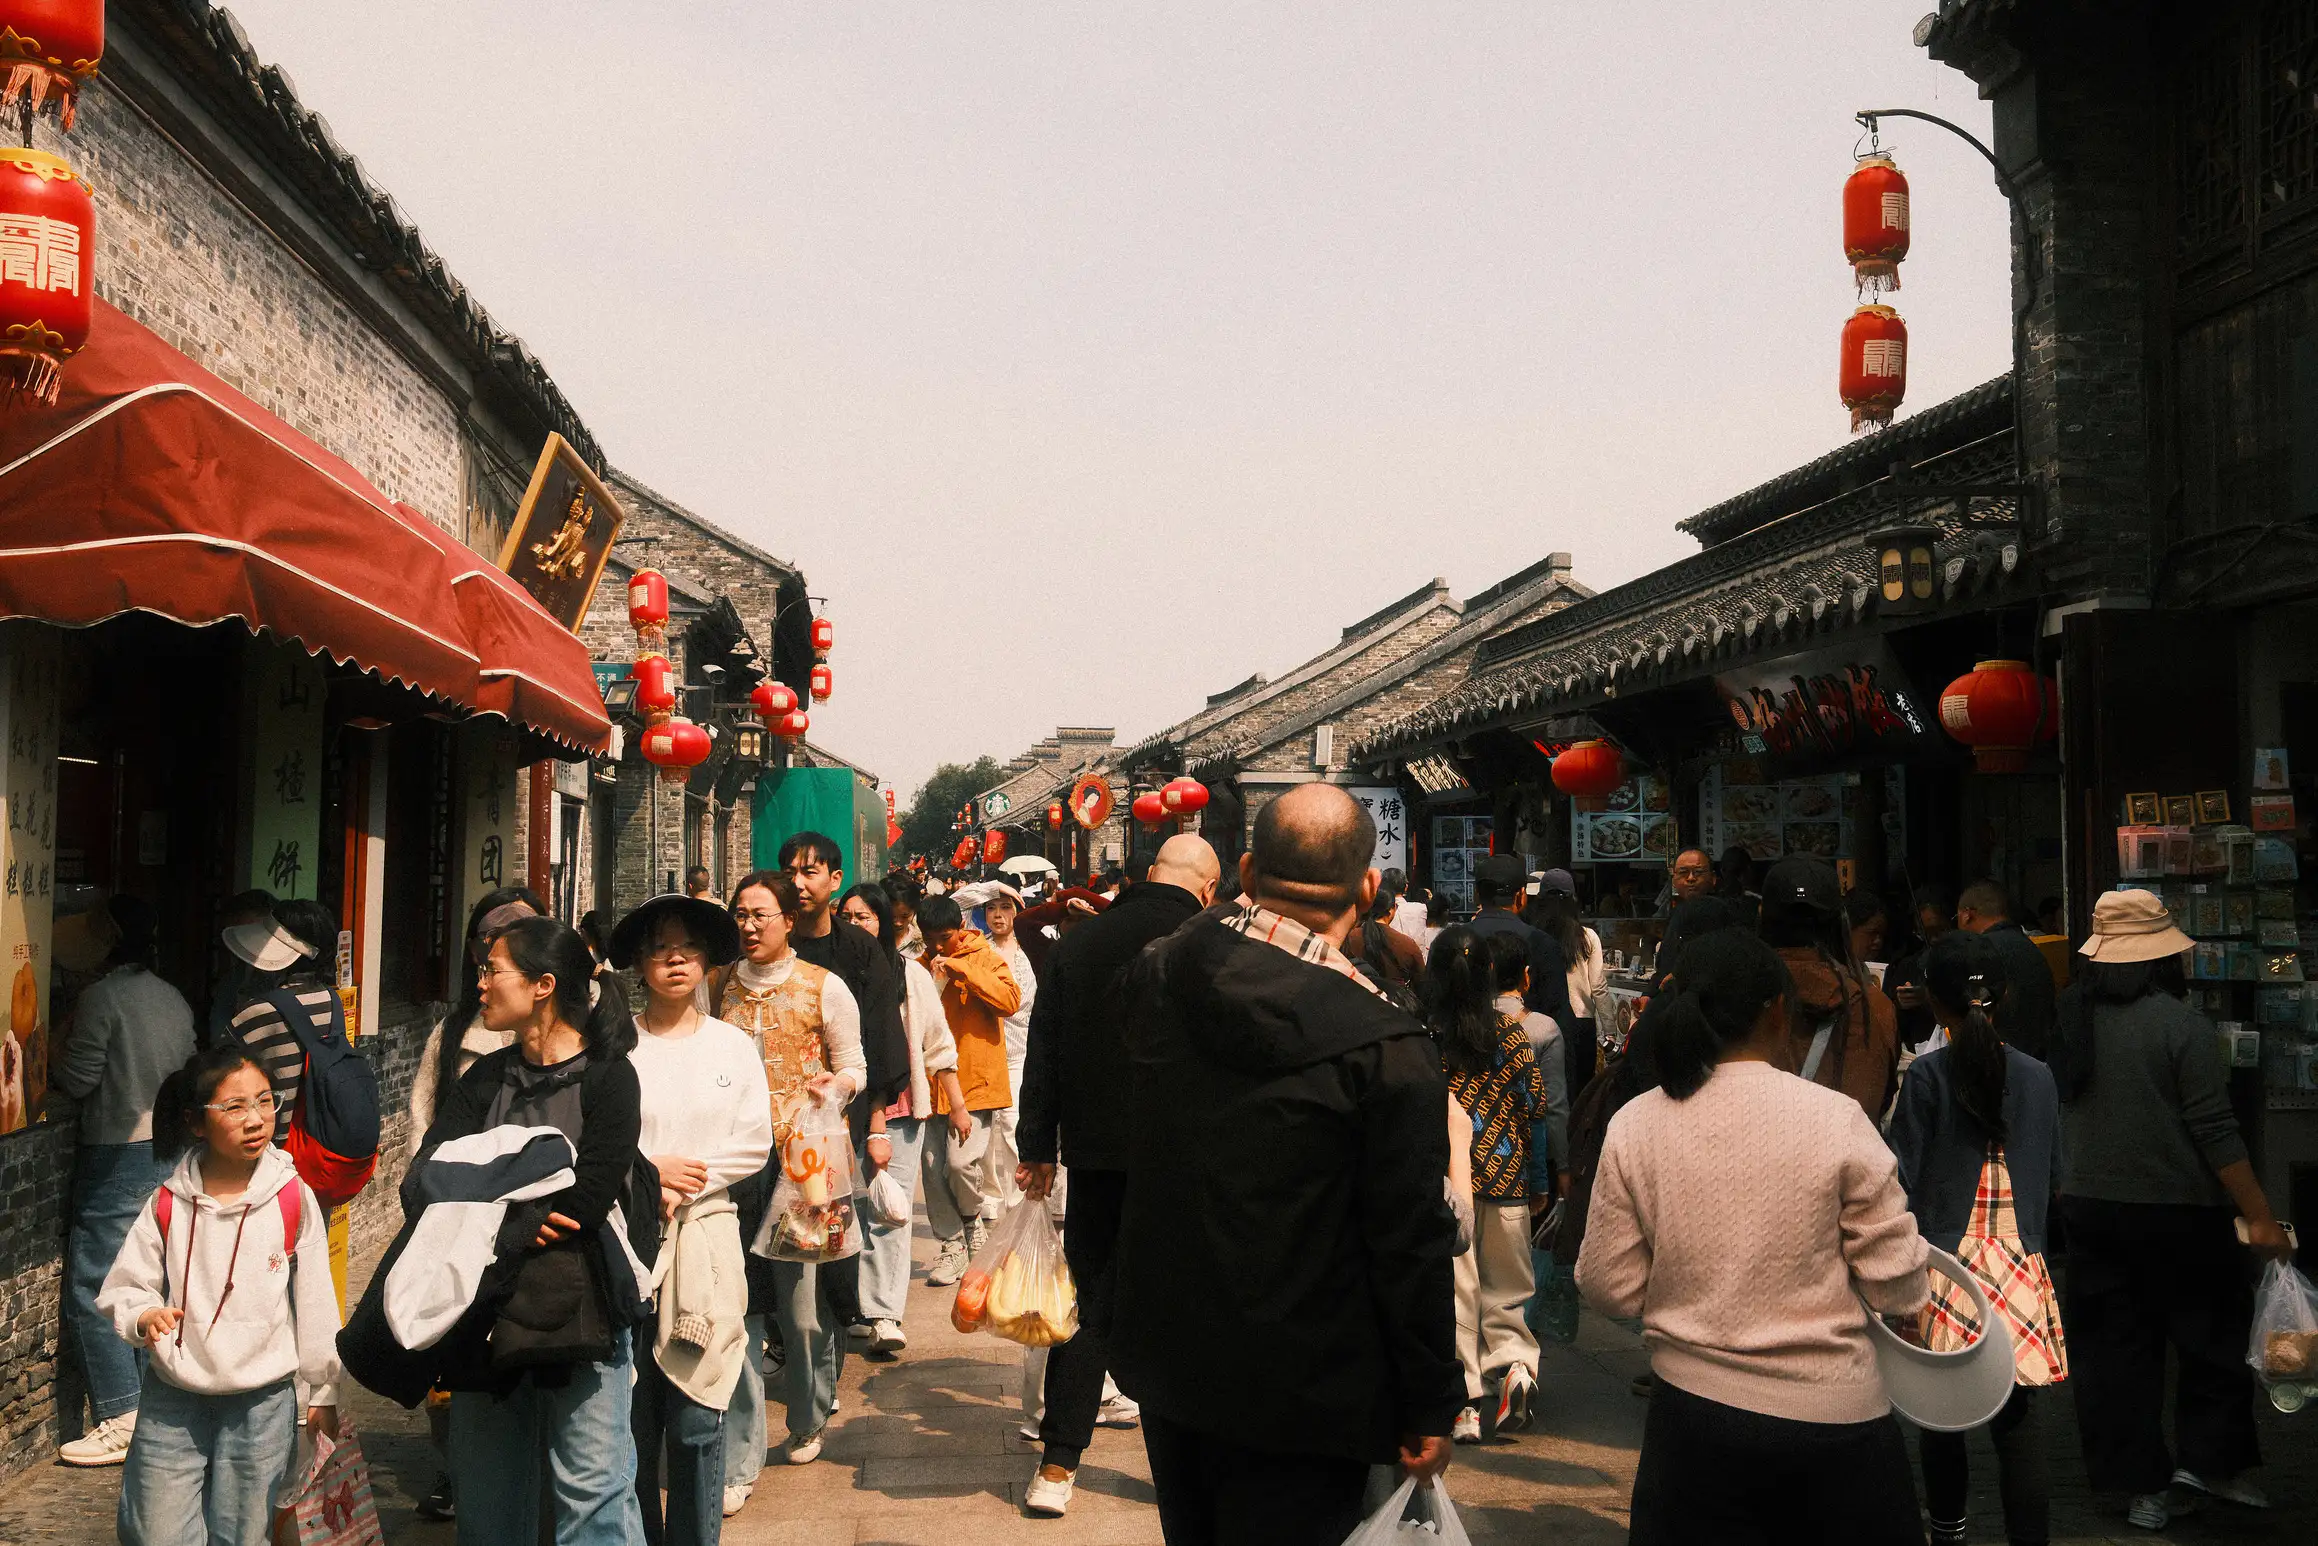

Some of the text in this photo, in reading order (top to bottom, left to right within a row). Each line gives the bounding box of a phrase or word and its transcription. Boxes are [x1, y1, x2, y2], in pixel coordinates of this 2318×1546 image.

[268, 663, 309, 900] 山楂饼
[1378, 798, 1402, 846] 糖水
